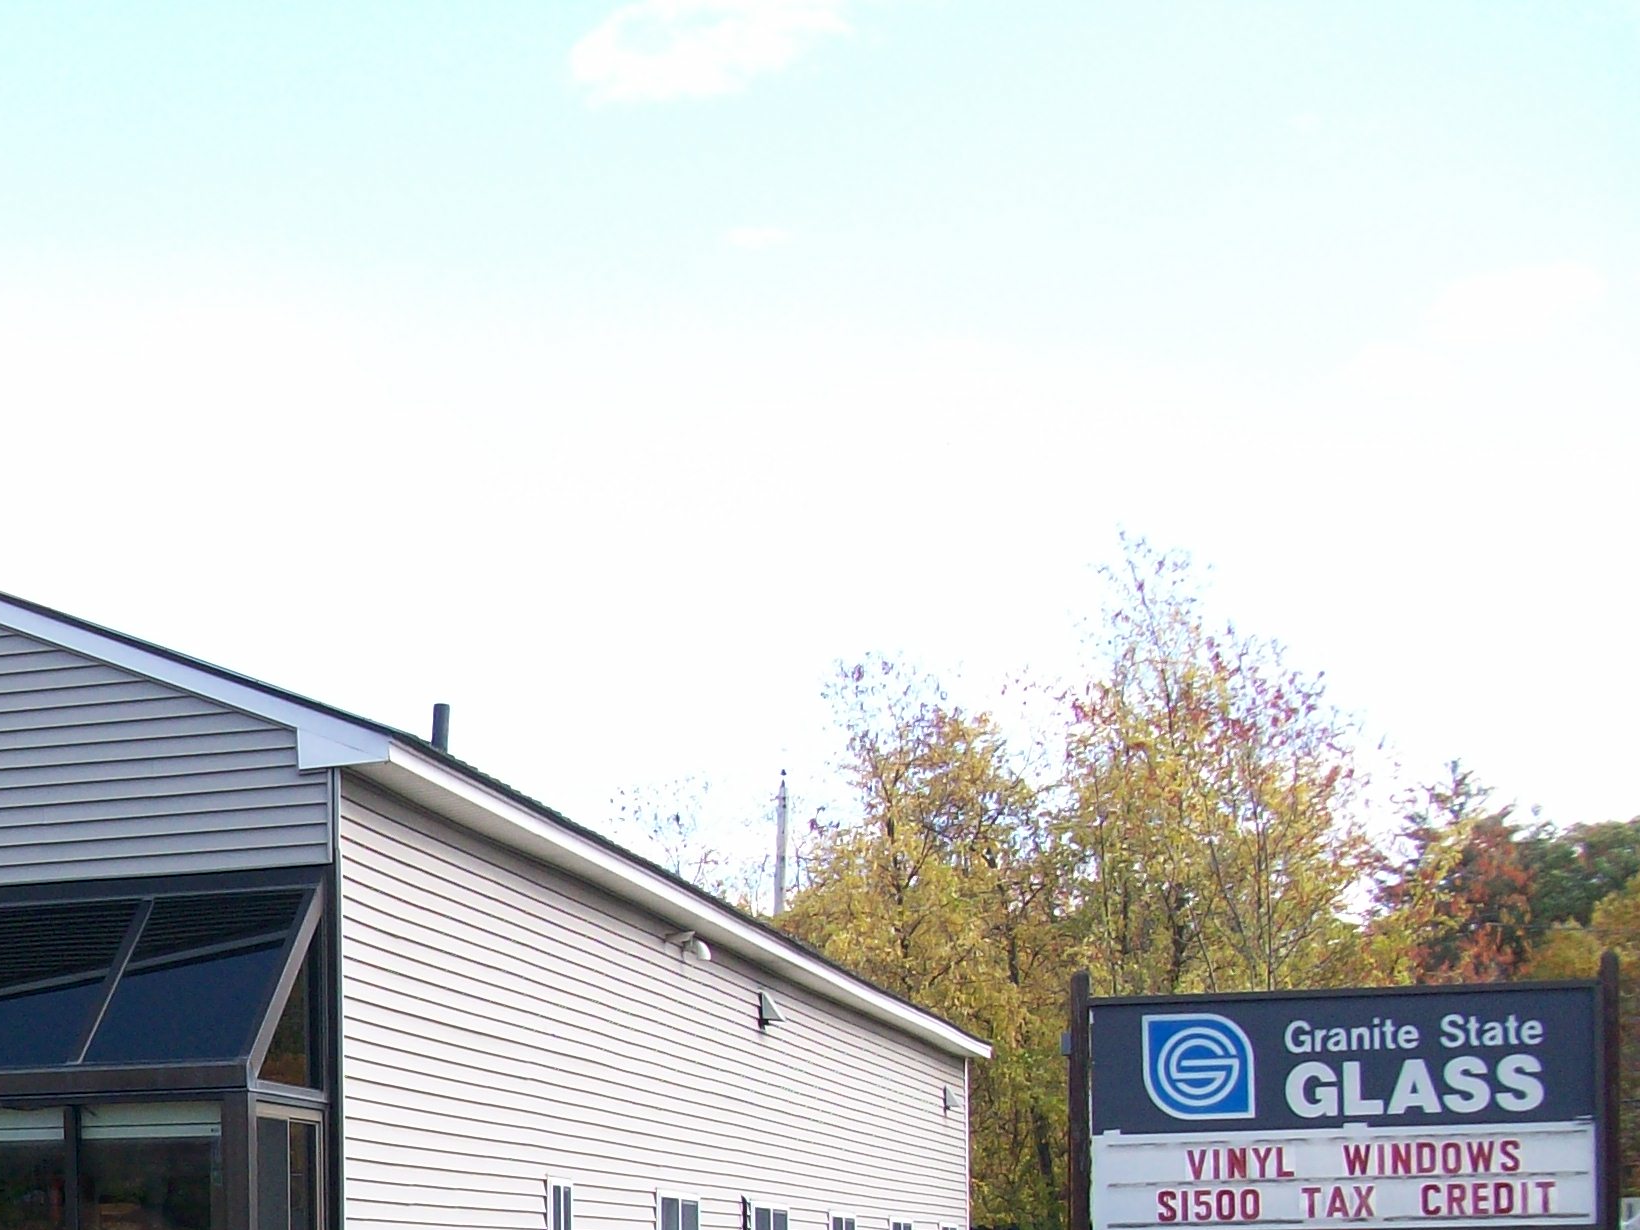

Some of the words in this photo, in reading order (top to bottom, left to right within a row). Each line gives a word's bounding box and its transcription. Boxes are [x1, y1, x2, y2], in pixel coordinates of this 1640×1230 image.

[1284, 1018, 1420, 1055] Granite
[1439, 1013, 1544, 1048] State
[1284, 1053, 1545, 1119] GLASS
[1186, 1146, 1295, 1180] VINYL
[1343, 1139, 1522, 1177] WINDOWS
[1157, 1188, 1261, 1223] $1500
[1301, 1184, 1375, 1219] TAX
[1420, 1180, 1556, 1217] CREDIT
